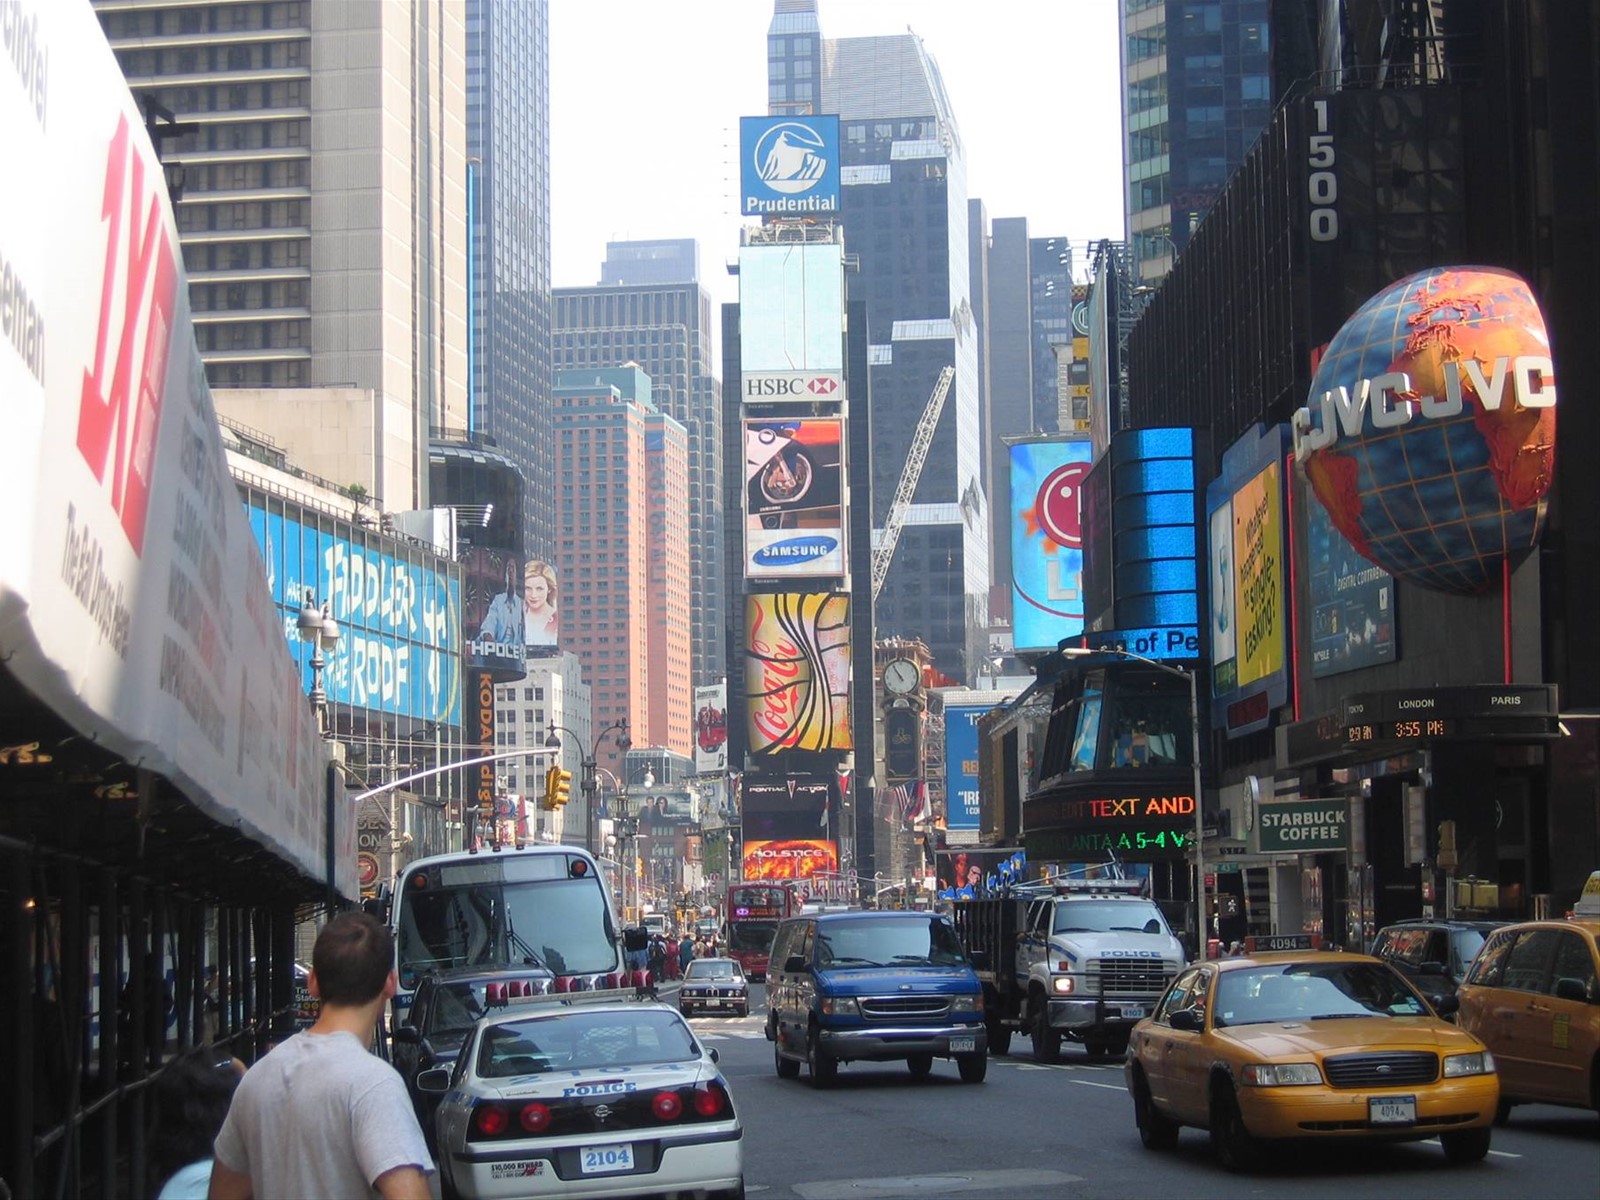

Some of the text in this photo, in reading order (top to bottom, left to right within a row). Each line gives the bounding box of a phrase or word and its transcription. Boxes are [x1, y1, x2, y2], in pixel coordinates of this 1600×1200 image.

[1308, 101, 1339, 242] 1500
[747, 195, 836, 212] Prudential
[746, 378, 804, 396] HSBC
[1420, 355, 1558, 420] JVC
[1308, 371, 1413, 451] JVC
[762, 545, 828, 557] SAMSUNG
[325, 543, 417, 633] FIDDLER
[1136, 632, 1159, 653] of
[352, 637, 409, 706] ROOF
[1399, 699, 1435, 710] LONDON
[1491, 696, 1521, 705] PARIS
[1089, 798, 1141, 817] TEXT
[1145, 796, 1194, 815] AND
[1137, 831, 1166, 849] 5-4
[1279, 826, 1339, 841] COFFEE
[754, 849, 823, 858] OLSTICE
[1100, 950, 1162, 959] POLICE
[563, 1082, 637, 1098] POLICE
[586, 1150, 630, 1166] 2104
